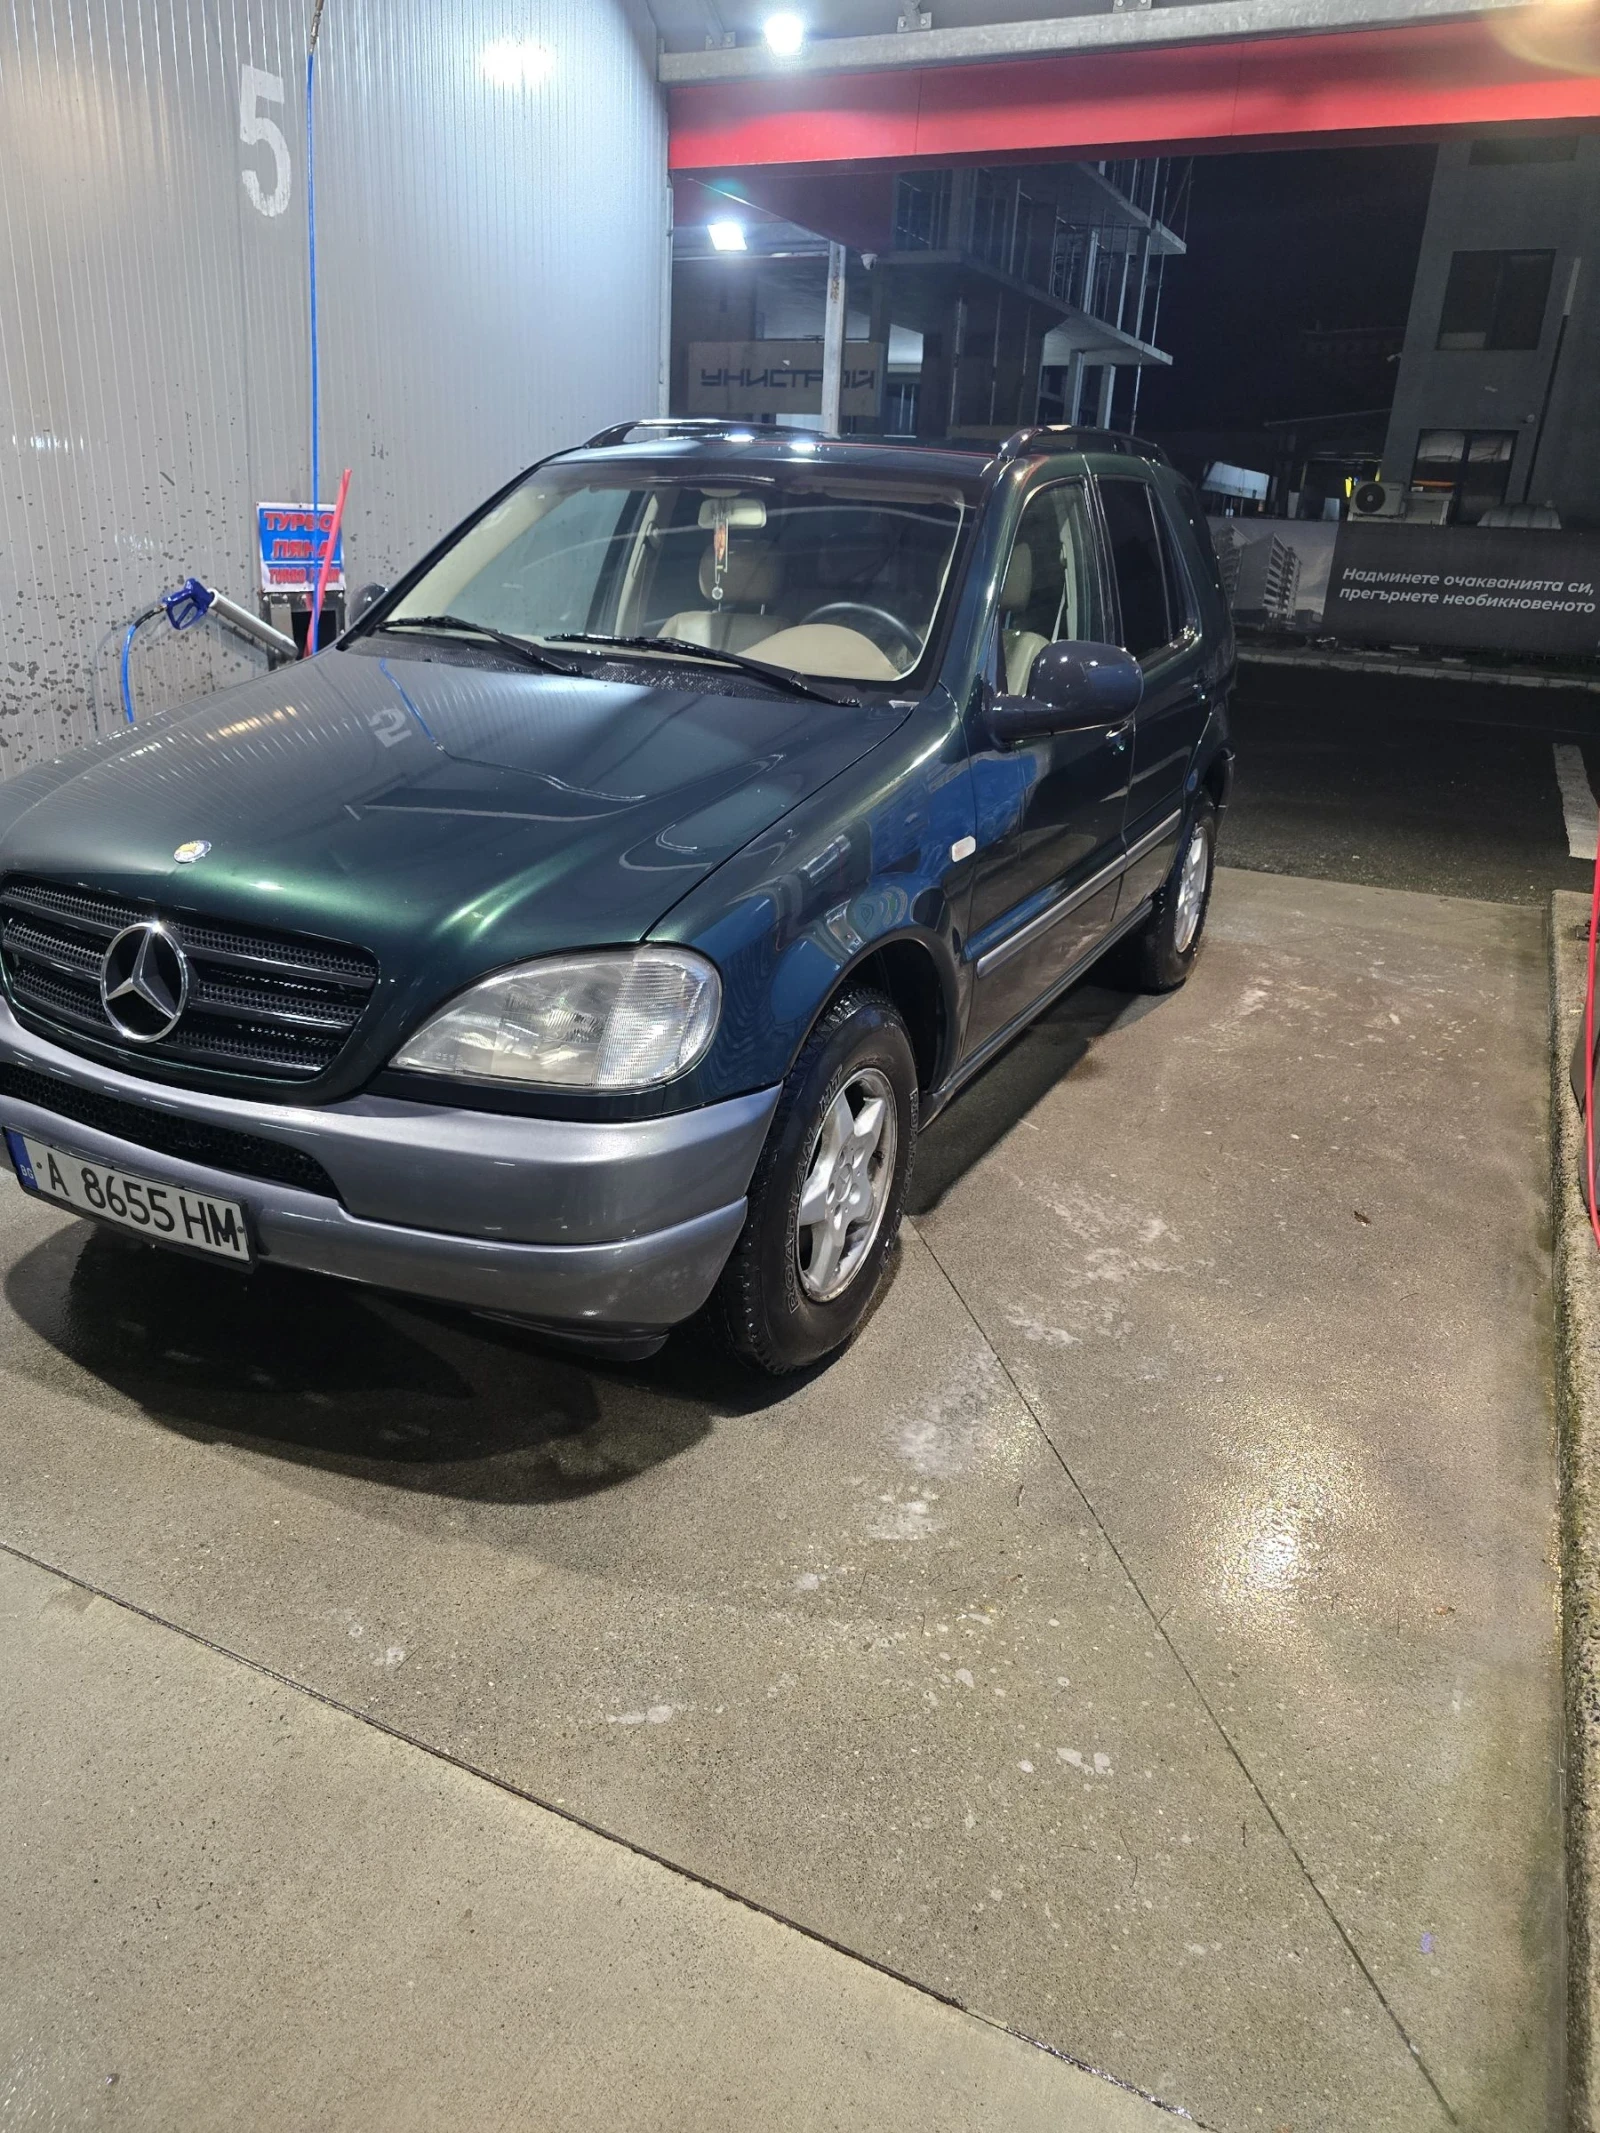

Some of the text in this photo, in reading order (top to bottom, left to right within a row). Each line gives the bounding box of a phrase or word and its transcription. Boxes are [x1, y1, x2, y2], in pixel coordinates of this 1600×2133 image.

[239, 64, 292, 218] 5
[1341, 567, 1595, 595] Надминете очакванията си,
[1338, 587, 1596, 614] прегърнете необикновеното
[20, 1164, 35, 1180] BG
[80, 1167, 176, 1233] 8655
